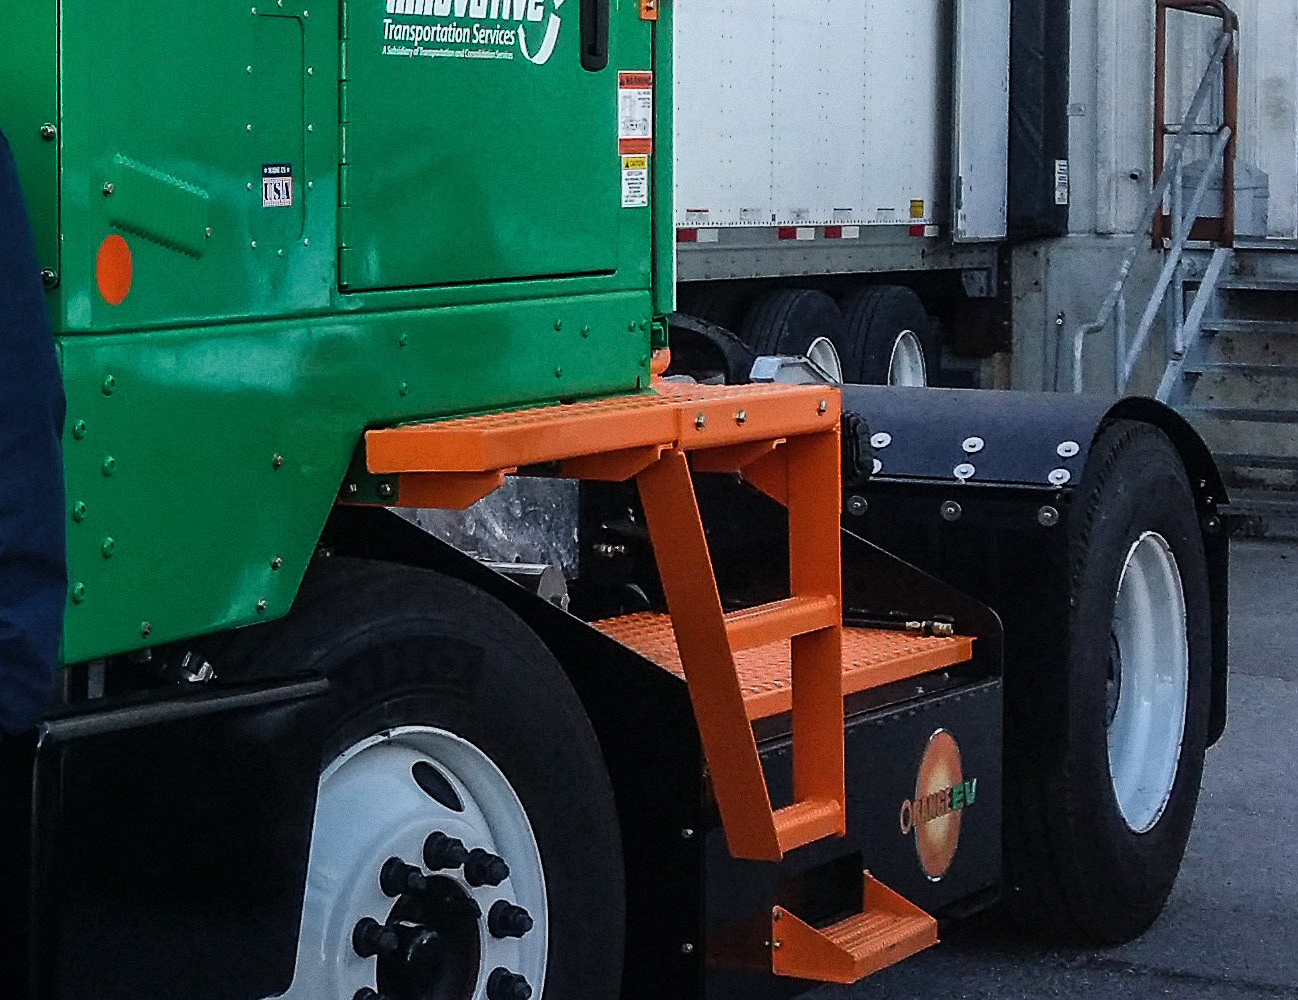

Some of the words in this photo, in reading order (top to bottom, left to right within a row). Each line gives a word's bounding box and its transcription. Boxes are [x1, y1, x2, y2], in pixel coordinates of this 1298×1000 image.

[383, 18, 470, 47] Transportation
[471, 22, 516, 46] Services
[264, 182, 291, 201] USA
